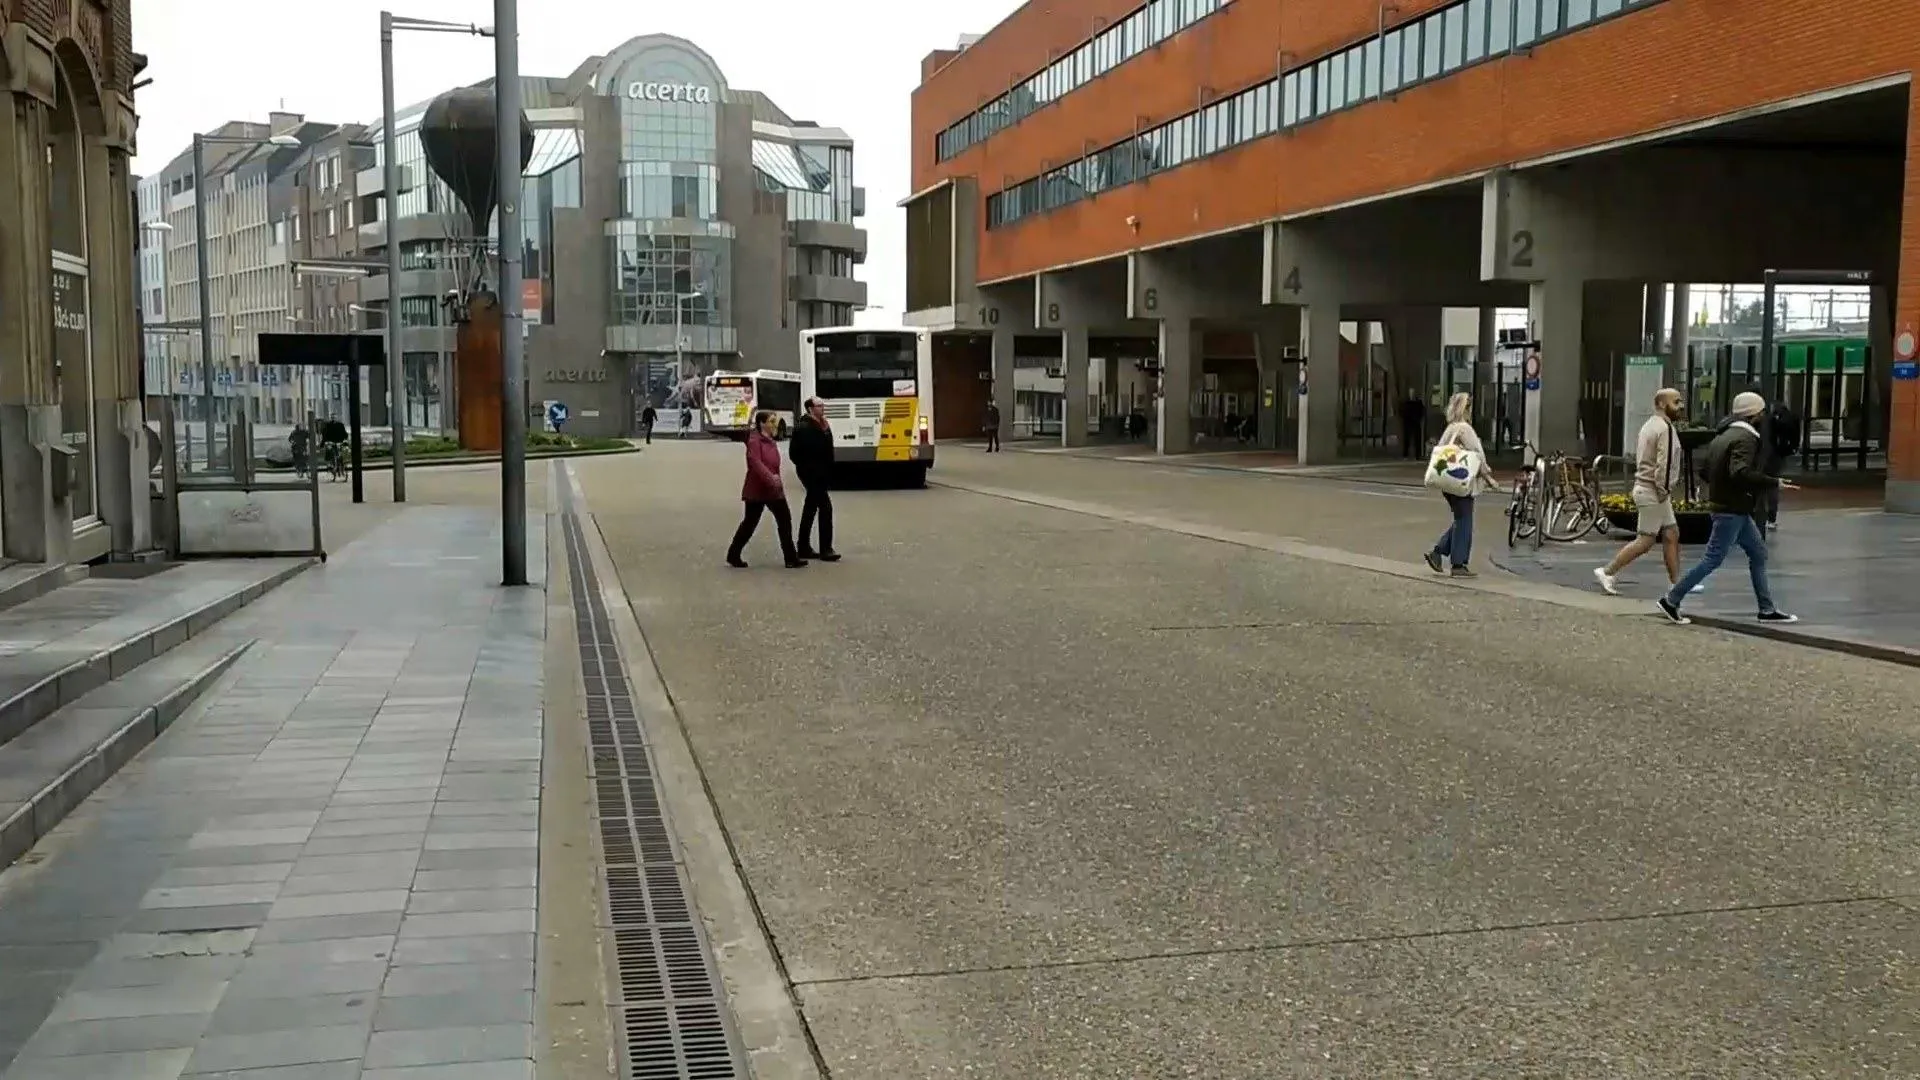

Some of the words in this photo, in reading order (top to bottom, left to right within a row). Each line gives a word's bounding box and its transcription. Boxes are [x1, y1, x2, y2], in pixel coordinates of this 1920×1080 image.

[628, 81, 709, 103] acerta
[1511, 230, 1534, 268] 2
[1283, 266, 1303, 296] 4
[1144, 287, 1158, 310] 6
[978, 306, 998, 325] 10
[1048, 303, 1059, 322] 8
[543, 366, 607, 382] acerta
